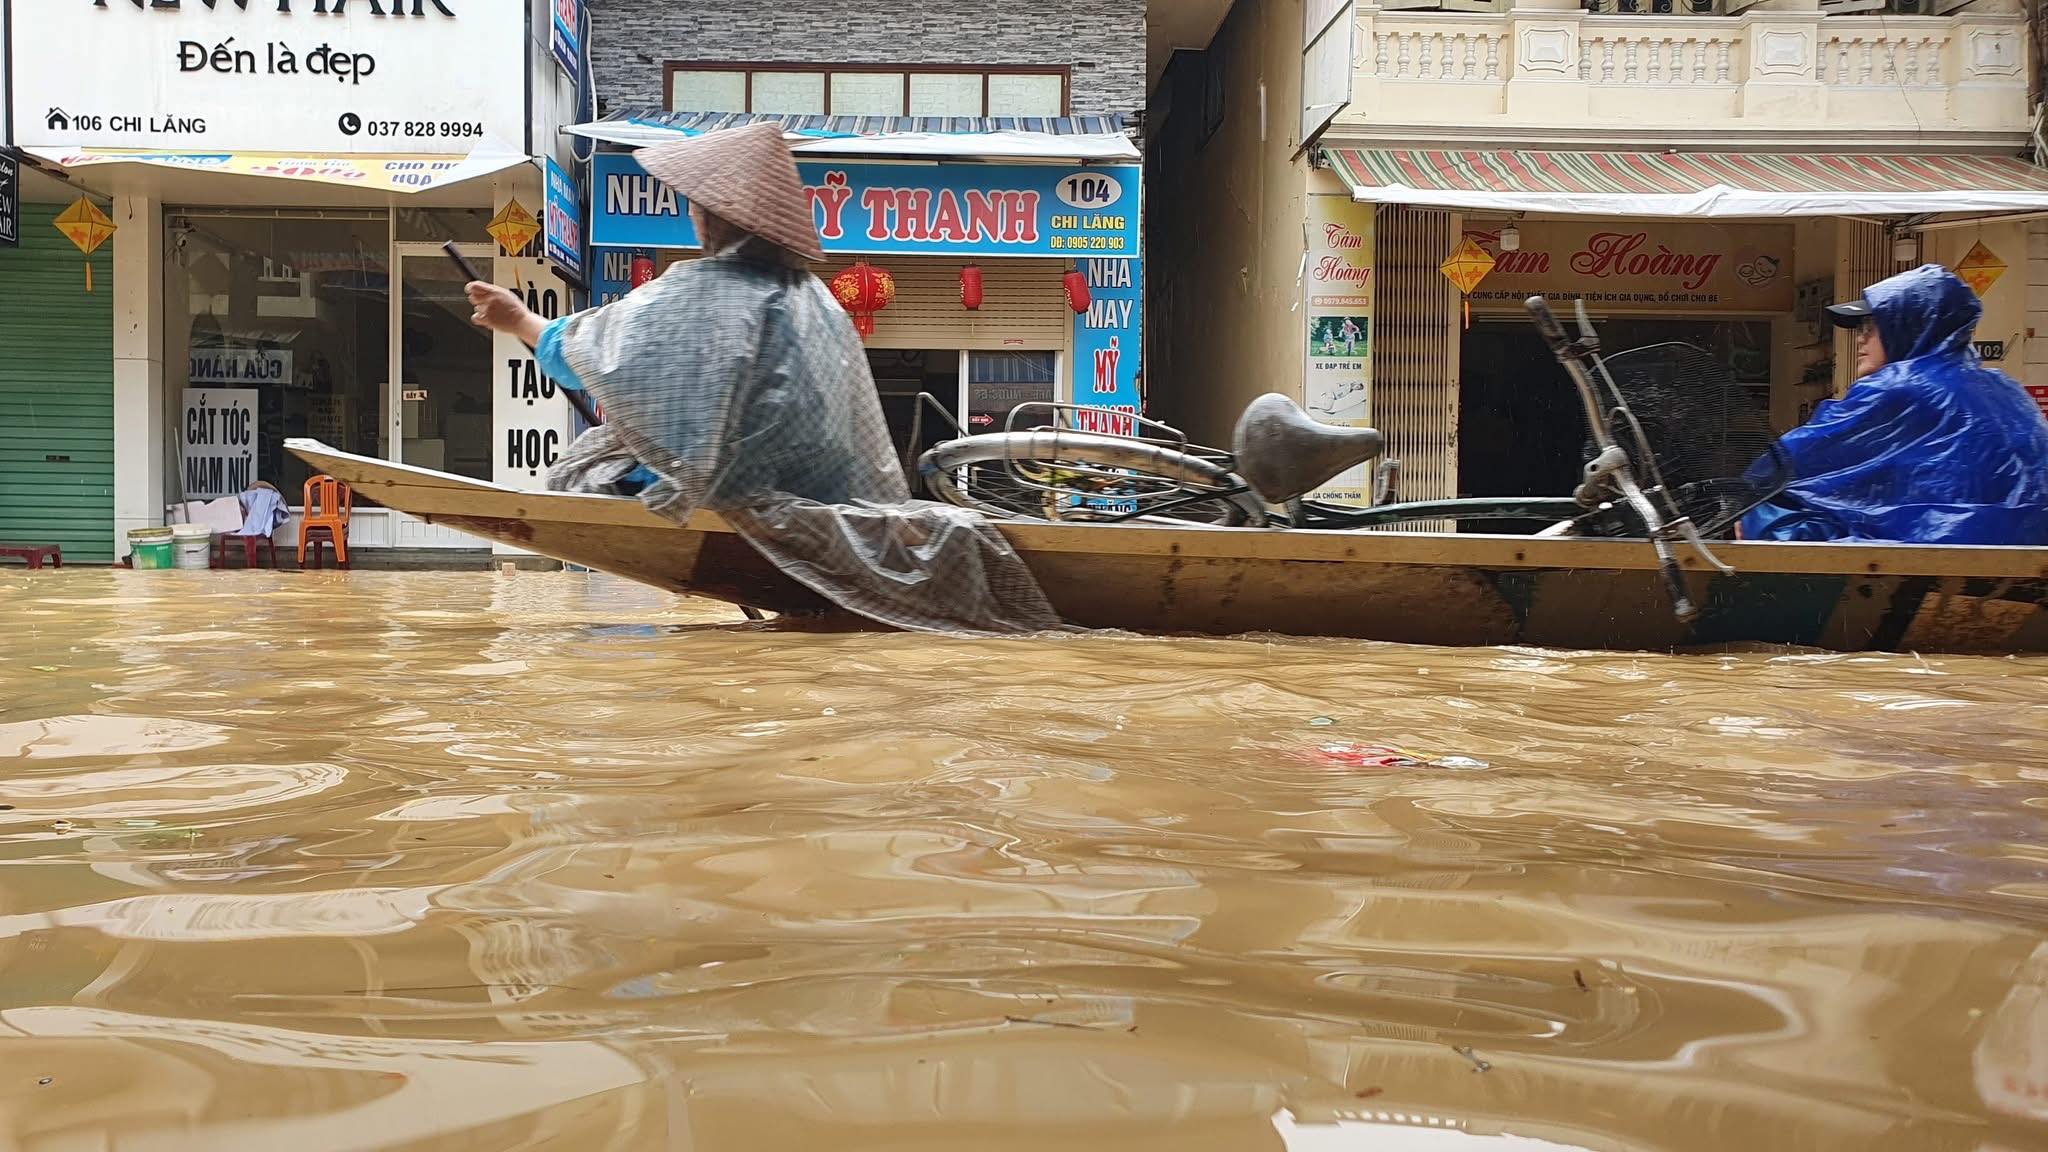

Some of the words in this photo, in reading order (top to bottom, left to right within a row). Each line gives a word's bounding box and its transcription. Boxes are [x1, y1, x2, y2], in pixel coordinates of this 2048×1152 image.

[177, 36, 257, 74] Đến
[267, 41, 299, 75] là
[306, 43, 376, 84] đẹp
[72, 116, 102, 131] 106
[109, 116, 142, 132] CHI
[150, 113, 207, 134] LĂNG
[368, 121, 400, 137] 037
[404, 122, 436, 138] 828
[438, 122, 484, 138] 9994
[385, 161, 424, 170] CHO
[431, 161, 459, 170] DI
[607, 174, 678, 215] NHA
[1067, 178, 1110, 203] 104
[862, 186, 1040, 243] THANH
[1051, 215, 1077, 229] CHI
[1082, 212, 1125, 230] LĂNG
[1067, 236, 1088, 248] 0905
[1090, 237, 1106, 248] 220
[1108, 237, 1124, 249] 903
[1323, 222, 1362, 249] Tâm
[604, 252, 633, 281] NH
[1087, 258, 1132, 288] NHA
[1313, 255, 1370, 289] Hoàng
[1570, 232, 1722, 290] Hoàng
[509, 280, 558, 321] ÀO
[1084, 299, 1133, 329] MAY
[1092, 336, 1120, 393] MỸ
[1352, 362, 1362, 370] EM
[508, 359, 556, 406] TẠO
[186, 393, 217, 445] CẮT
[221, 400, 250, 446] TÓC
[1077, 405, 1135, 438] THANH
[507, 428, 559, 476] HỌC
[186, 457, 223, 494] NAM
[228, 450, 252, 494] NỮ
